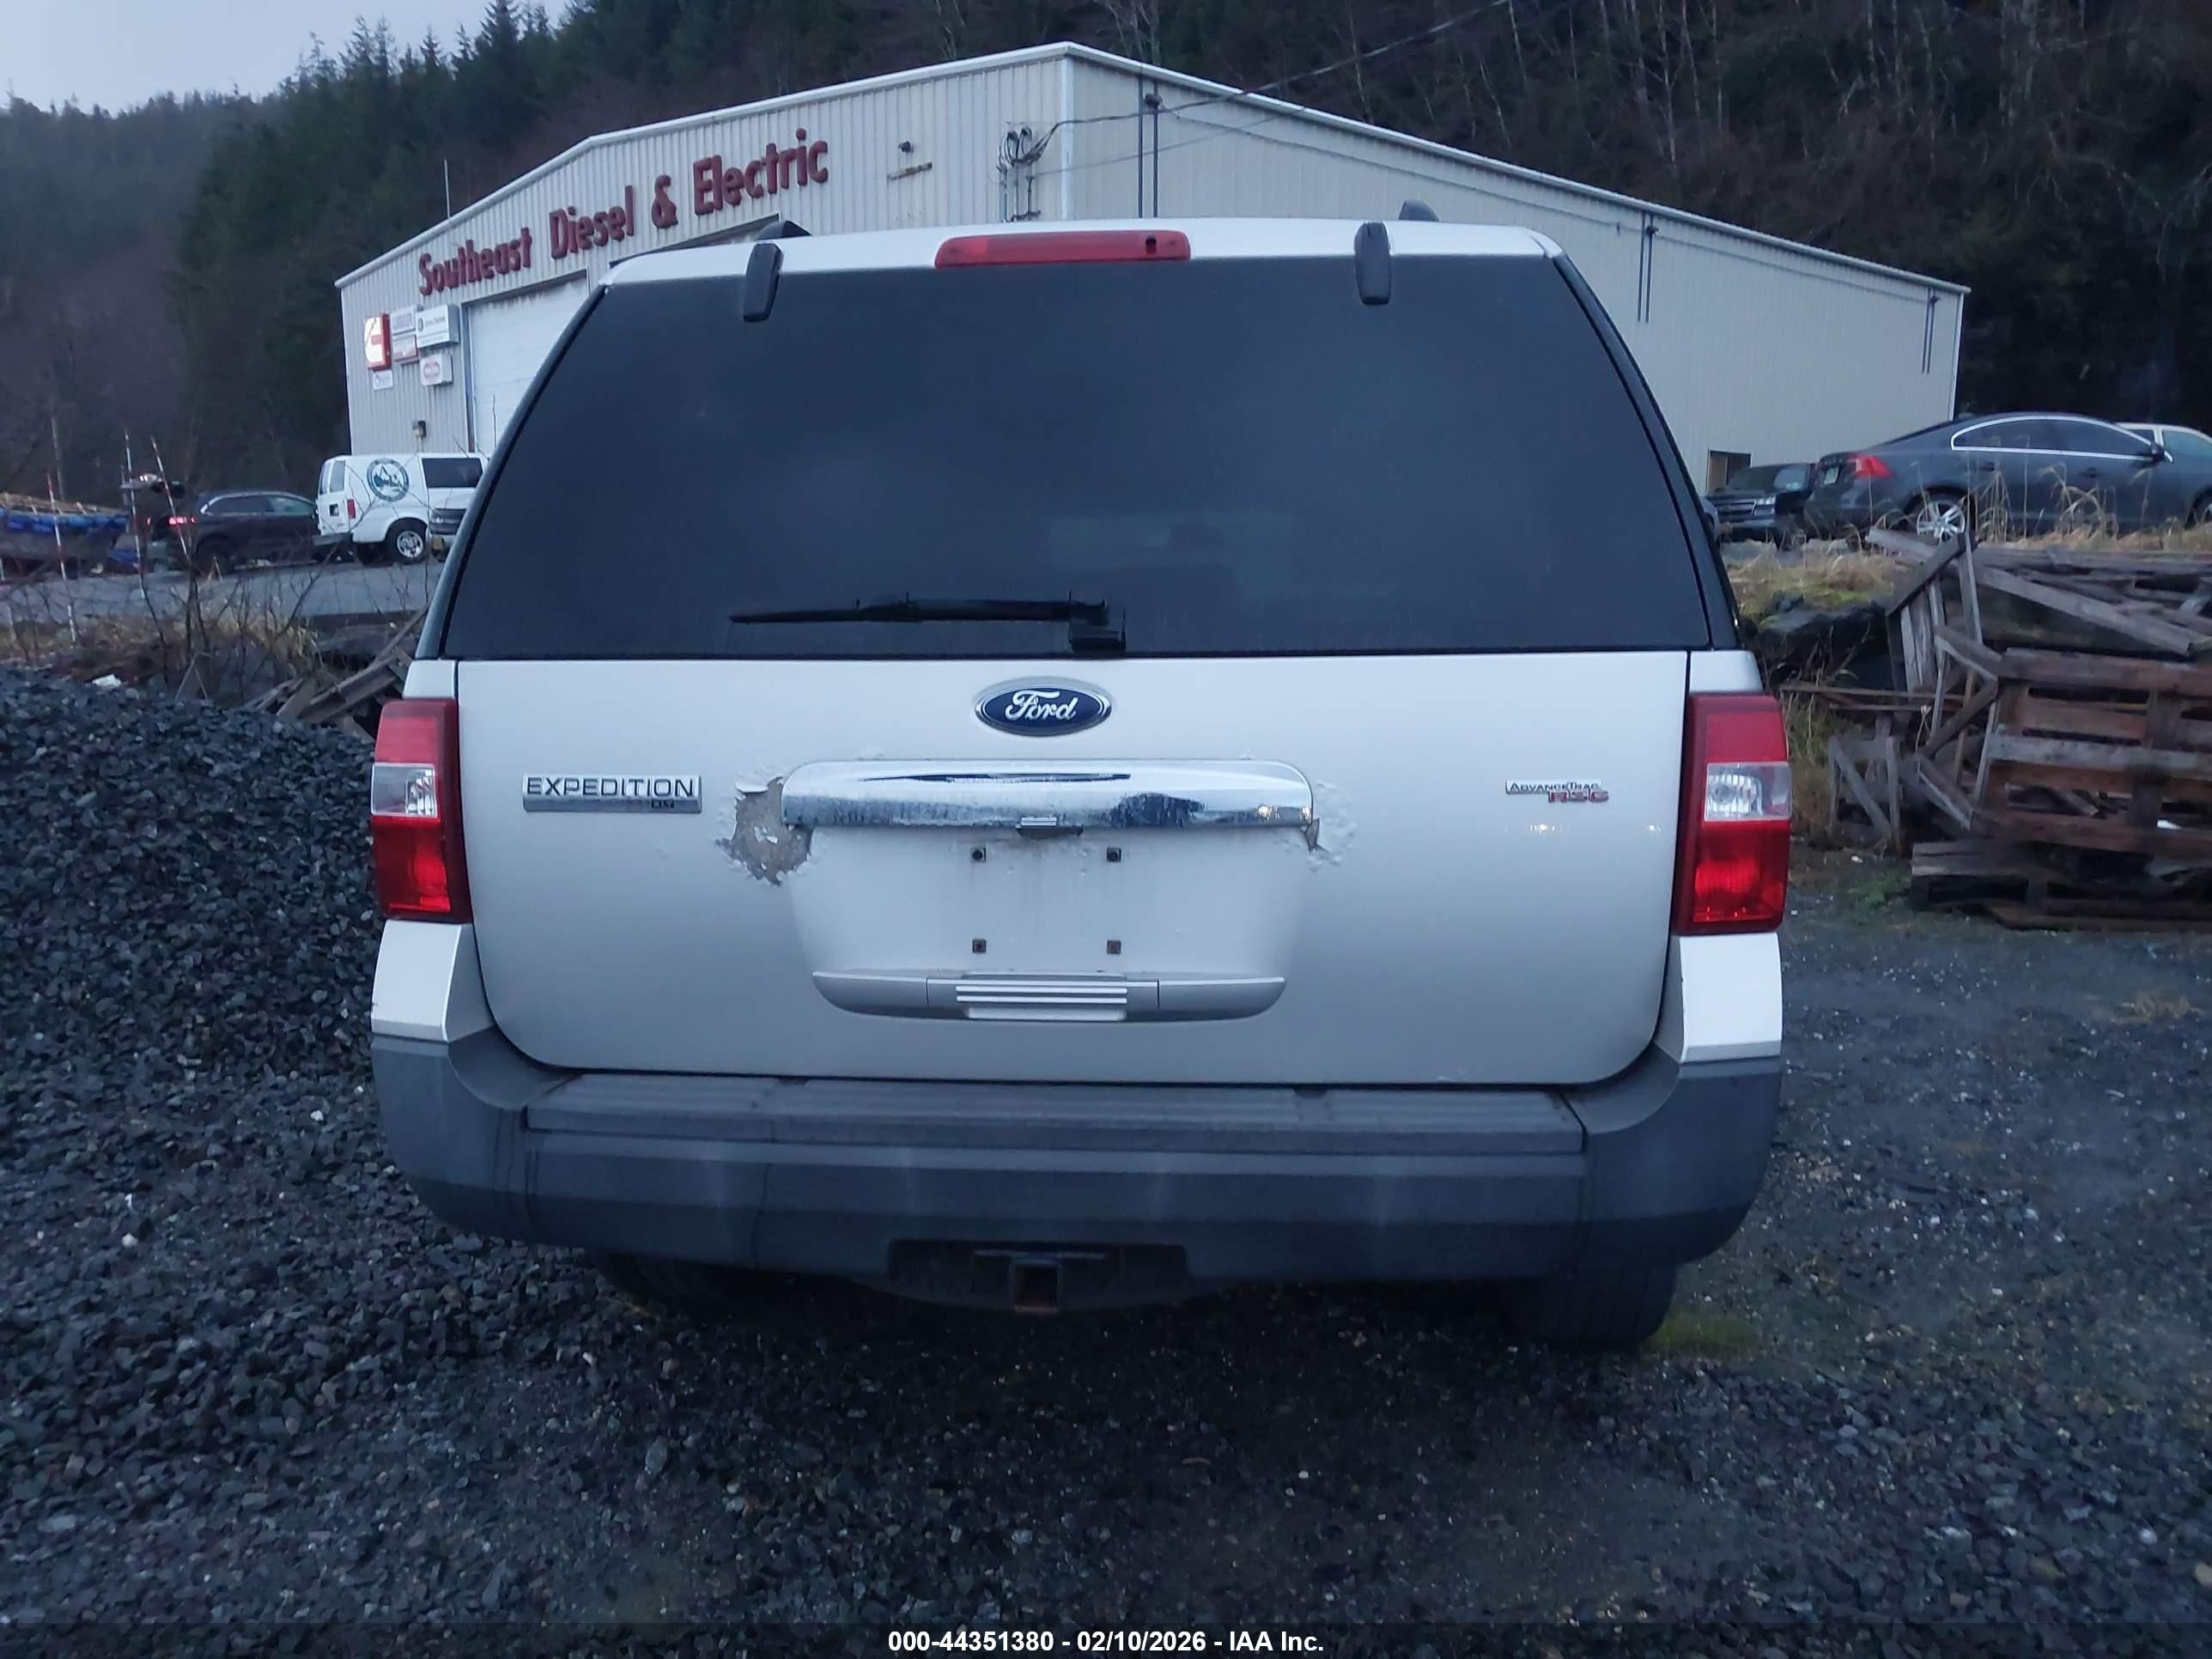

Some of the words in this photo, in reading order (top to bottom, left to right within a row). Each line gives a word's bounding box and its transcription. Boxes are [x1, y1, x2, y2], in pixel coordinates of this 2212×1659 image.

[418, 227, 532, 296] Southeast
[549, 184, 635, 259] Diesel
[651, 174, 678, 228] &
[693, 128, 829, 216] Electric
[1005, 690, 1079, 720] Ford
[526, 776, 694, 798] EXPEDITION
